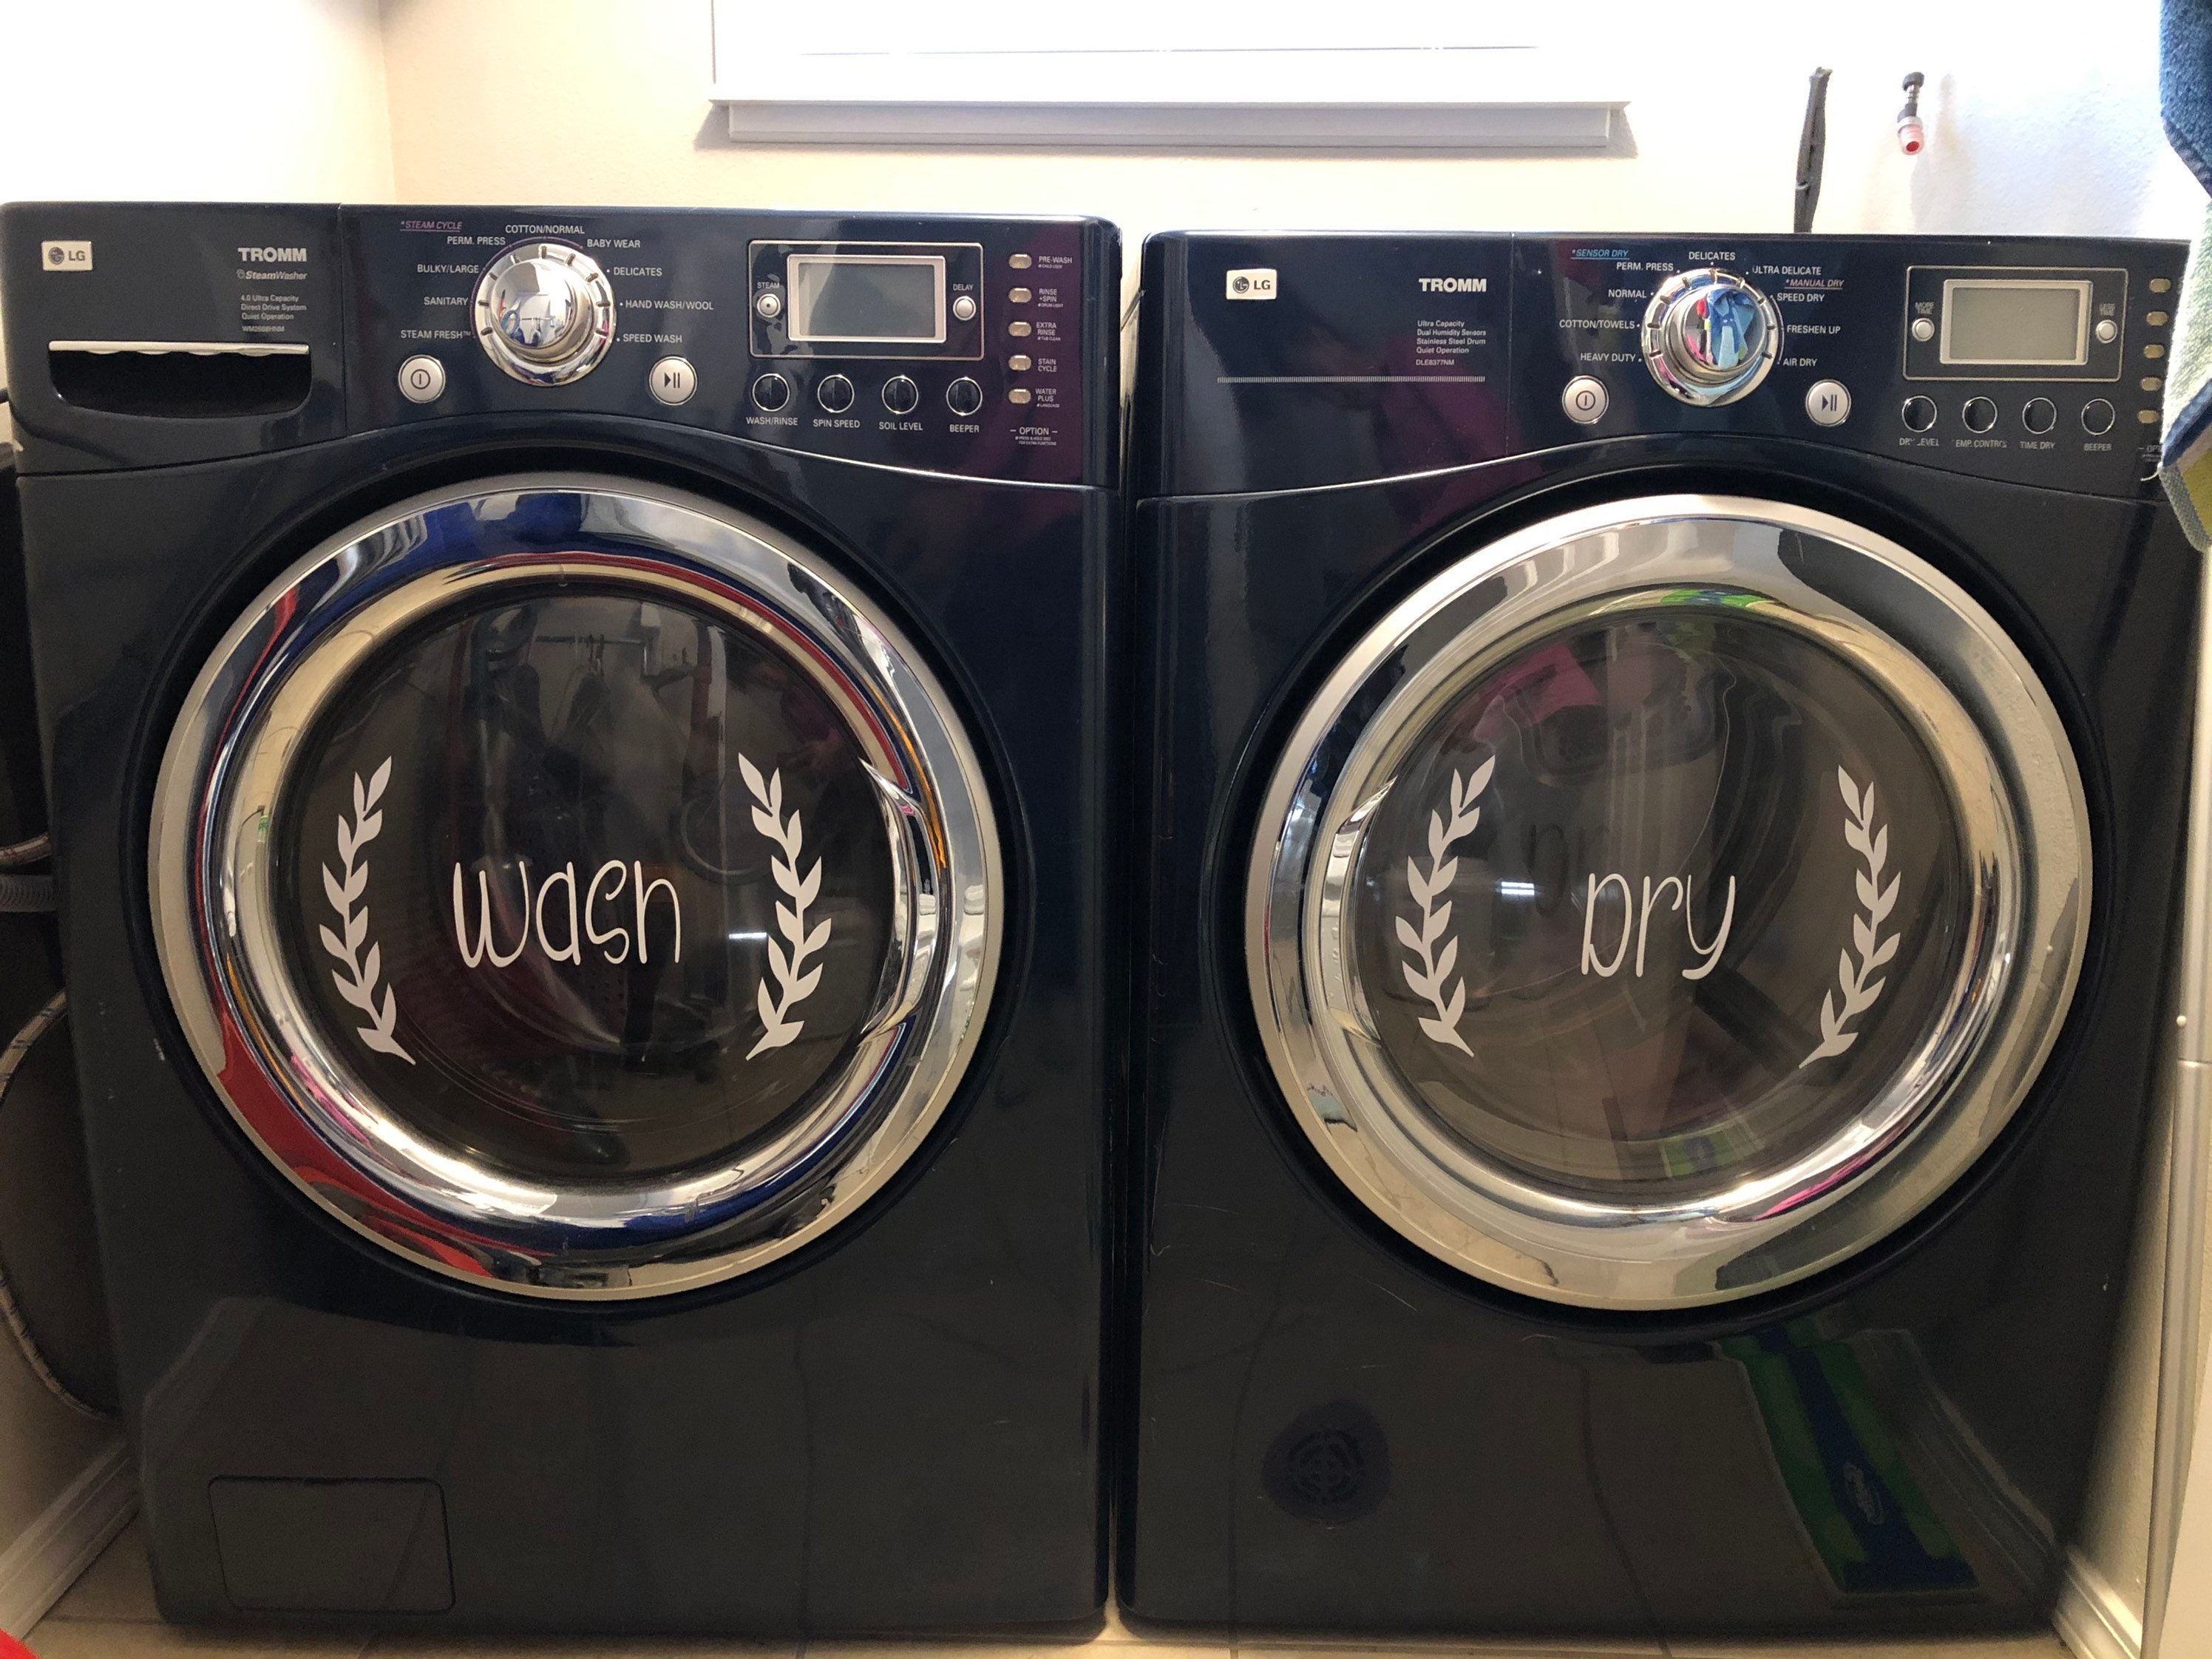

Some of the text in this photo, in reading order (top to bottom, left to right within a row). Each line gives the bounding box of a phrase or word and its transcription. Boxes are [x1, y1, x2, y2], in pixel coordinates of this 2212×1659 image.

[436, 222, 463, 230] CYCLE
[505, 225, 585, 234] COTTON/NORMAL
[447, 236, 506, 245] PERM. PRESS
[587, 239, 640, 248] BABY WEAR
[68, 250, 86, 261] LG
[237, 246, 308, 262] TROMM
[1611, 249, 1629, 257] DRY
[1689, 251, 1736, 260] DELICATES
[1039, 256, 1072, 264] PRE-WASH
[417, 264, 479, 274] BULKY/LARGE
[1616, 262, 1674, 271] PERM. PRESS
[1752, 265, 1822, 276] ULTRA DELICATE
[245, 271, 308, 280] SteamWasher
[614, 267, 662, 276] DELICATES
[1253, 279, 1271, 291] LG
[1418, 277, 1487, 293] TROMM
[1827, 279, 1845, 288] DRY
[1608, 288, 1647, 298] NORMAL
[1777, 293, 1825, 302] SPEED DRY
[270, 294, 299, 303] Capacity
[424, 296, 469, 305] SANITARY
[625, 299, 714, 311] HAND WASH/WOOL
[261, 313, 294, 321] Operation
[1435, 319, 1465, 328] Capacity
[1559, 319, 1635, 329] COTTON/TOWELS
[1786, 325, 1841, 334] FRESHEN UP
[400, 330, 432, 339] STEAM
[622, 333, 682, 343] SPEED WASH
[1580, 353, 1636, 362] HEAVY DUTY
[1782, 358, 1817, 367] AIR DRY
[746, 417, 798, 426] WASH/RINSE
[812, 419, 861, 428] SPIN SPEED
[878, 421, 923, 431] SOIL LEVEL
[949, 424, 980, 432] BEEPER
[1019, 427, 1049, 435] OPTION
[1916, 438, 1940, 447] EVEL
[1952, 439, 1972, 447] EMP.
[2020, 441, 2055, 449] TIME DRY
[2083, 443, 2112, 452] BEEPER
